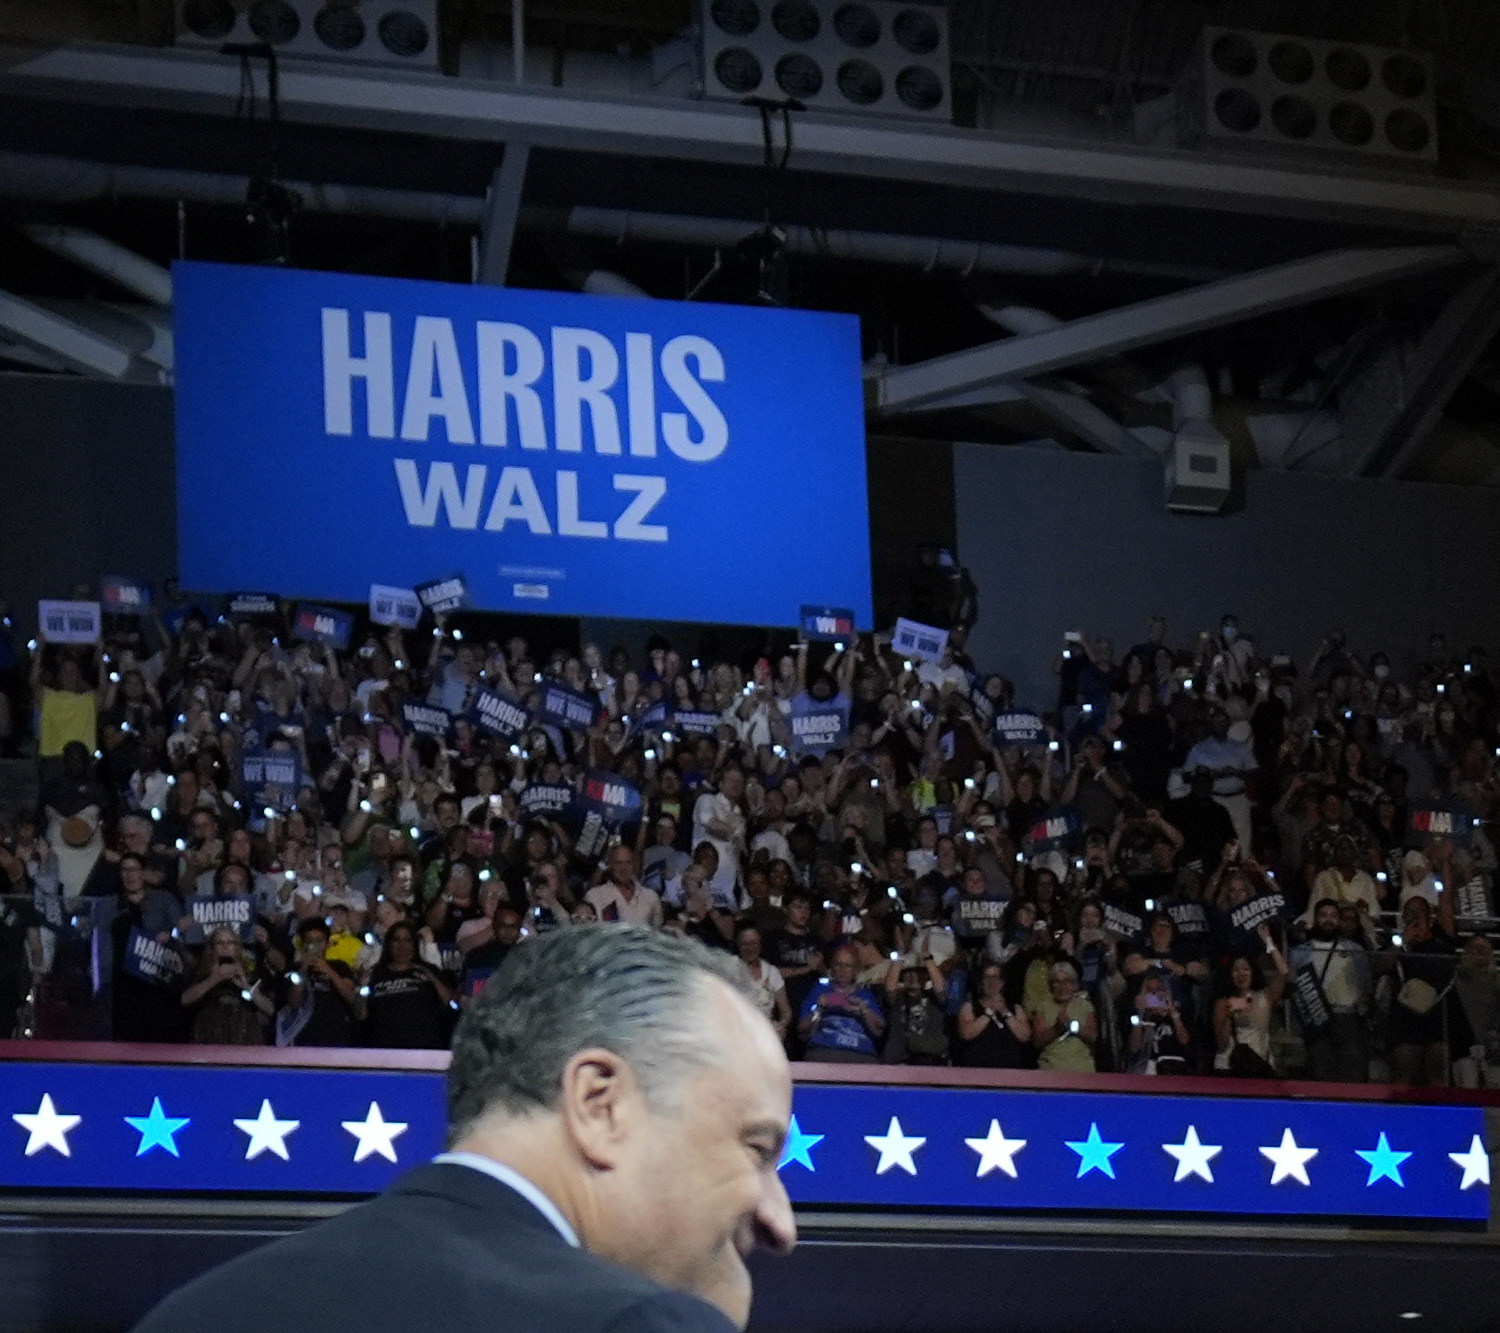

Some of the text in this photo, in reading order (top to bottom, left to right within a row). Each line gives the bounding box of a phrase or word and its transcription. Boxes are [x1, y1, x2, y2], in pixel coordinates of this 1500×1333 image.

[322, 308, 728, 461] HARRIS
[394, 458, 669, 541] WALZ
[192, 901, 250, 922] HARRIS
